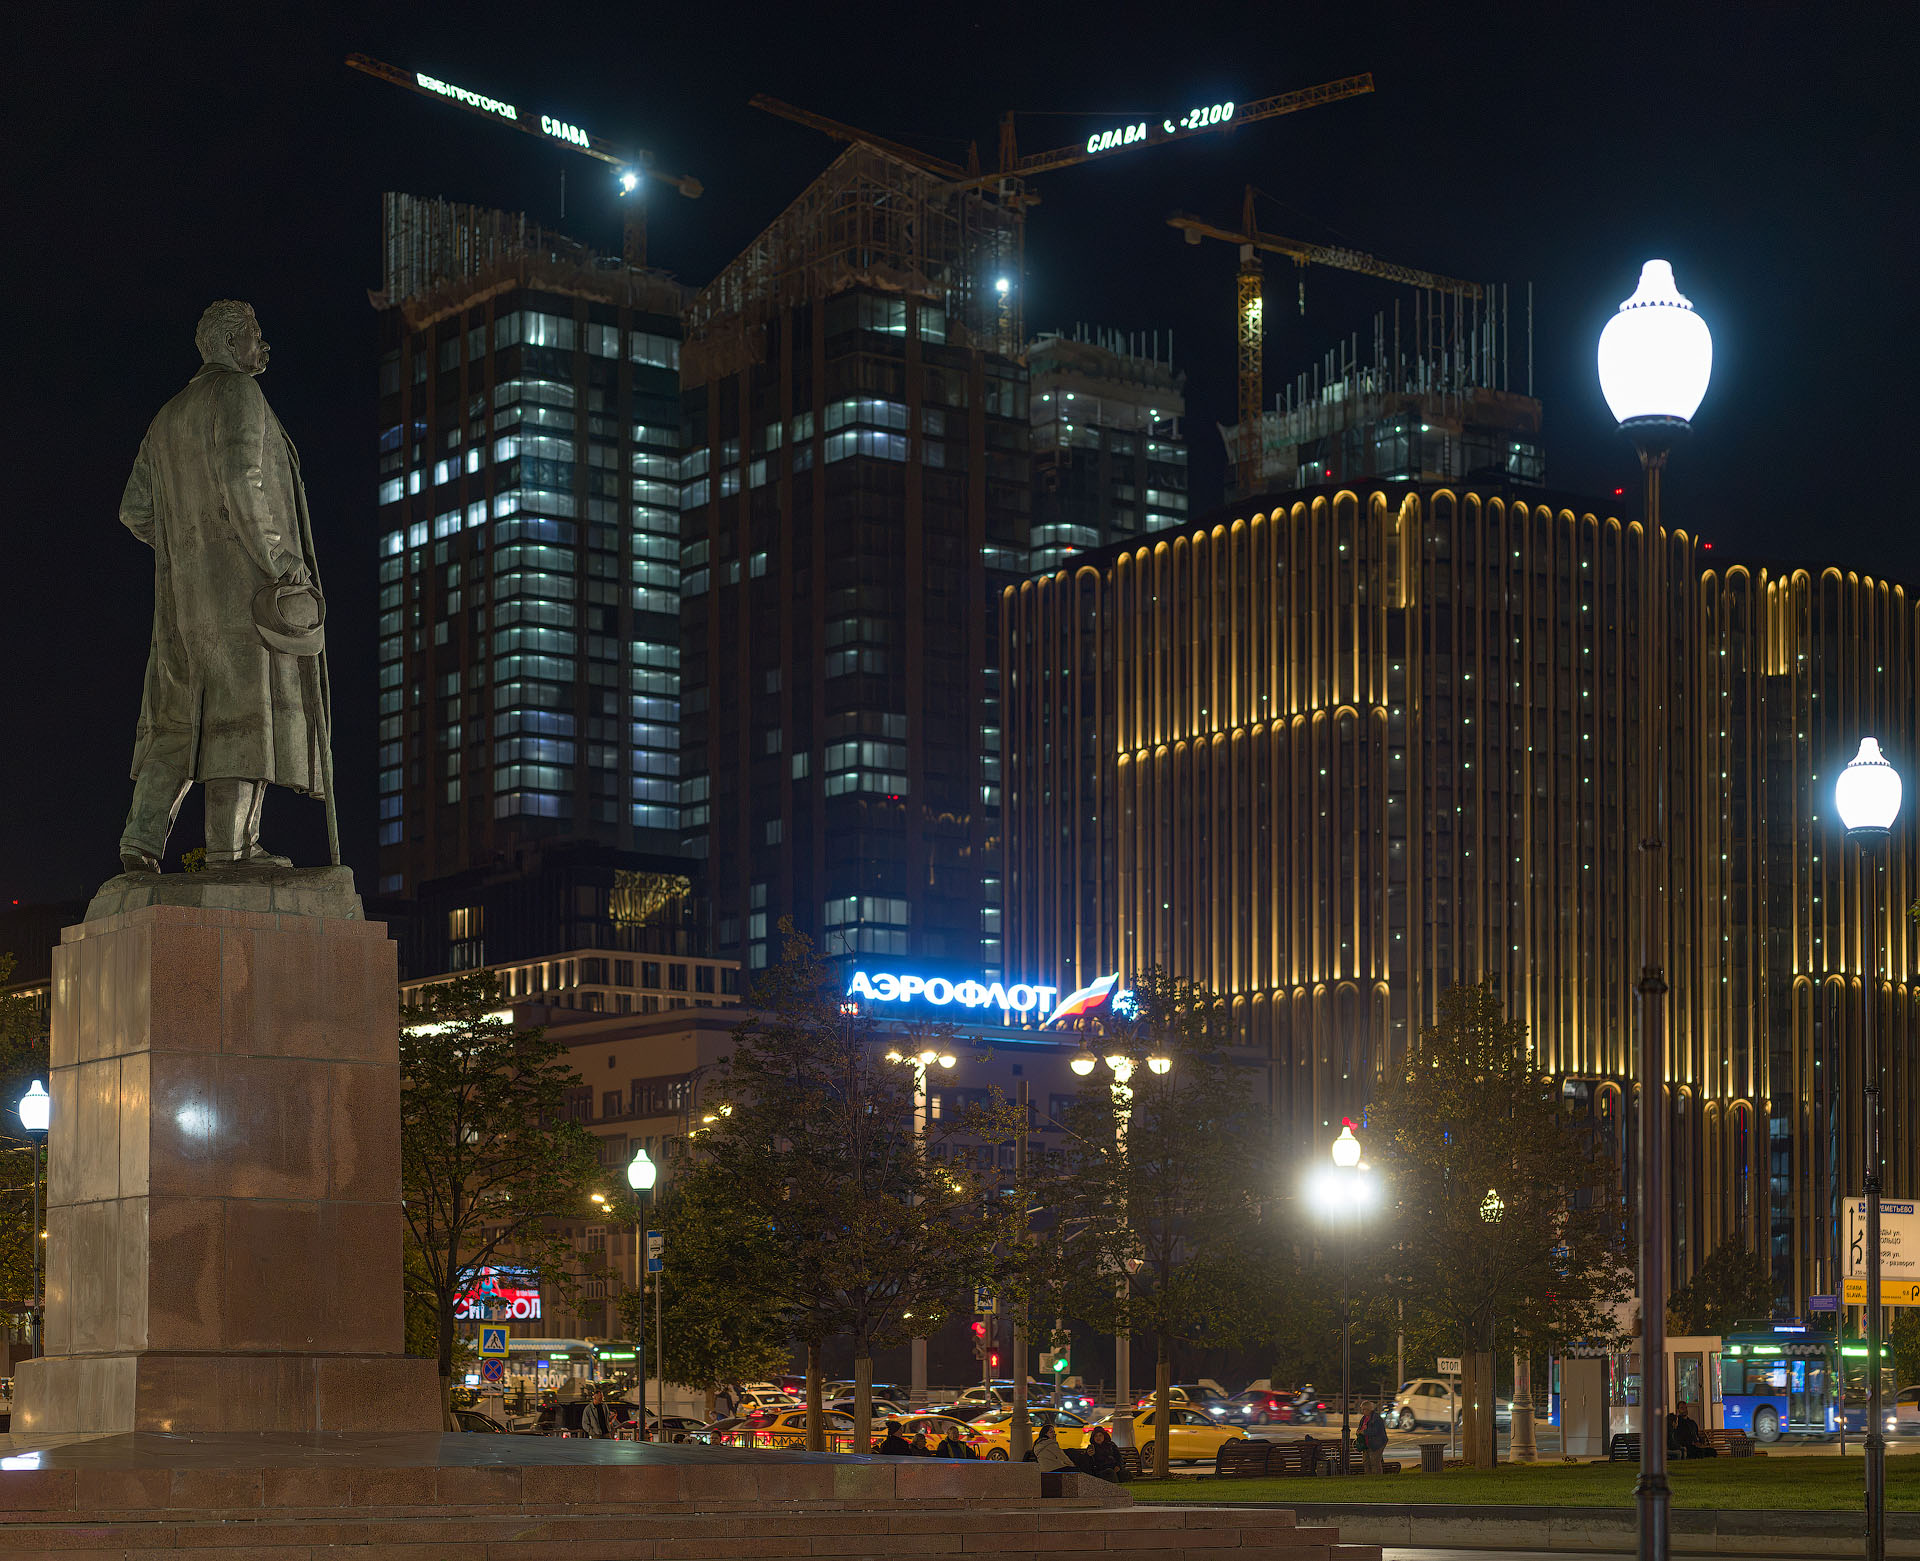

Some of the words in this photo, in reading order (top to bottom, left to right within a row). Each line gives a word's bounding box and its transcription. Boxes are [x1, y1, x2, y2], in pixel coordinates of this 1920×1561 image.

[541, 115, 590, 149] СЛАВА
[1087, 122, 1147, 154] СЛАВА
[847, 970, 1057, 1013] АЭРОФЛОТ
[1440, 1360, 1459, 1371] СТОП
